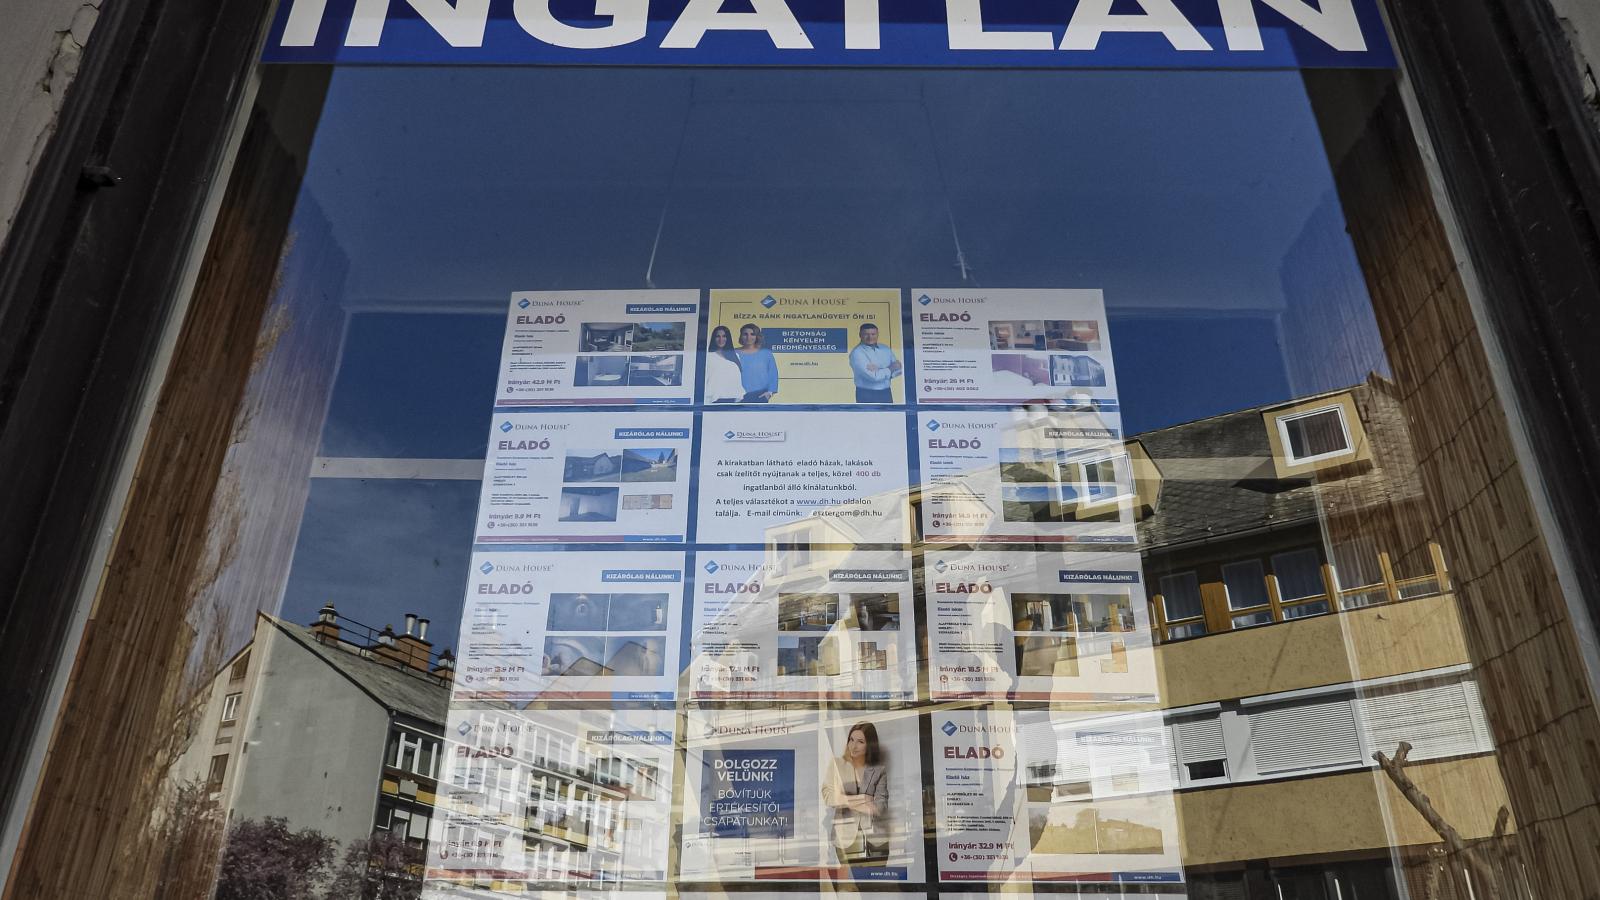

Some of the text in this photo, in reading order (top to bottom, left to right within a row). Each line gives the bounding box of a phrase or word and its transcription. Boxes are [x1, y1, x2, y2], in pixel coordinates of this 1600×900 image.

[779, 297, 846, 306] DUNA HOUSE
[933, 296, 956, 304] DUNA
[516, 314, 566, 324] ELADÓ
[733, 312, 757, 320] BÍZZA
[759, 312, 781, 320] RÁNK
[783, 312, 850, 320] INGATLANÜGYEIT
[852, 312, 865, 320] ÖN
[920, 310, 972, 322] ELADÓ
[783, 336, 825, 344] KÉNYELEM
[968, 422, 995, 430] HOUSE
[498, 438, 550, 450] ELADÓ
[928, 437, 981, 449] ELADÓ
[762, 470, 800, 478] nyújtanak
[808, 470, 830, 478] teljes,
[744, 484, 786, 492] ingatlanból
[724, 498, 744, 506] teljes
[796, 498, 841, 506] www.dh.hu
[716, 510, 740, 518] találja.
[812, 510, 882, 518] esztergom@dh.hu
[496, 564, 551, 572] DUNA HOUSE
[720, 564, 776, 572] DUNA HOUS
[978, 564, 1008, 572] HOUSE
[478, 581, 534, 595] ELADÓ
[704, 580, 760, 594] ELADÓ
[936, 580, 992, 594] ELADÓ
[720, 725, 791, 735] DUNA HOUSE
[959, 724, 1019, 734] DUNA HOUE
[944, 744, 1004, 759] ELADÓ
[714, 759, 778, 770] DOLGOZZ
[718, 769, 774, 782] VELÜNK!
[718, 788, 772, 799] BŐVÍTJÜK
[704, 816, 788, 826] CSAPATUNKAT!
[948, 842, 977, 850] Irányár:
[978, 842, 994, 850] 32.9
